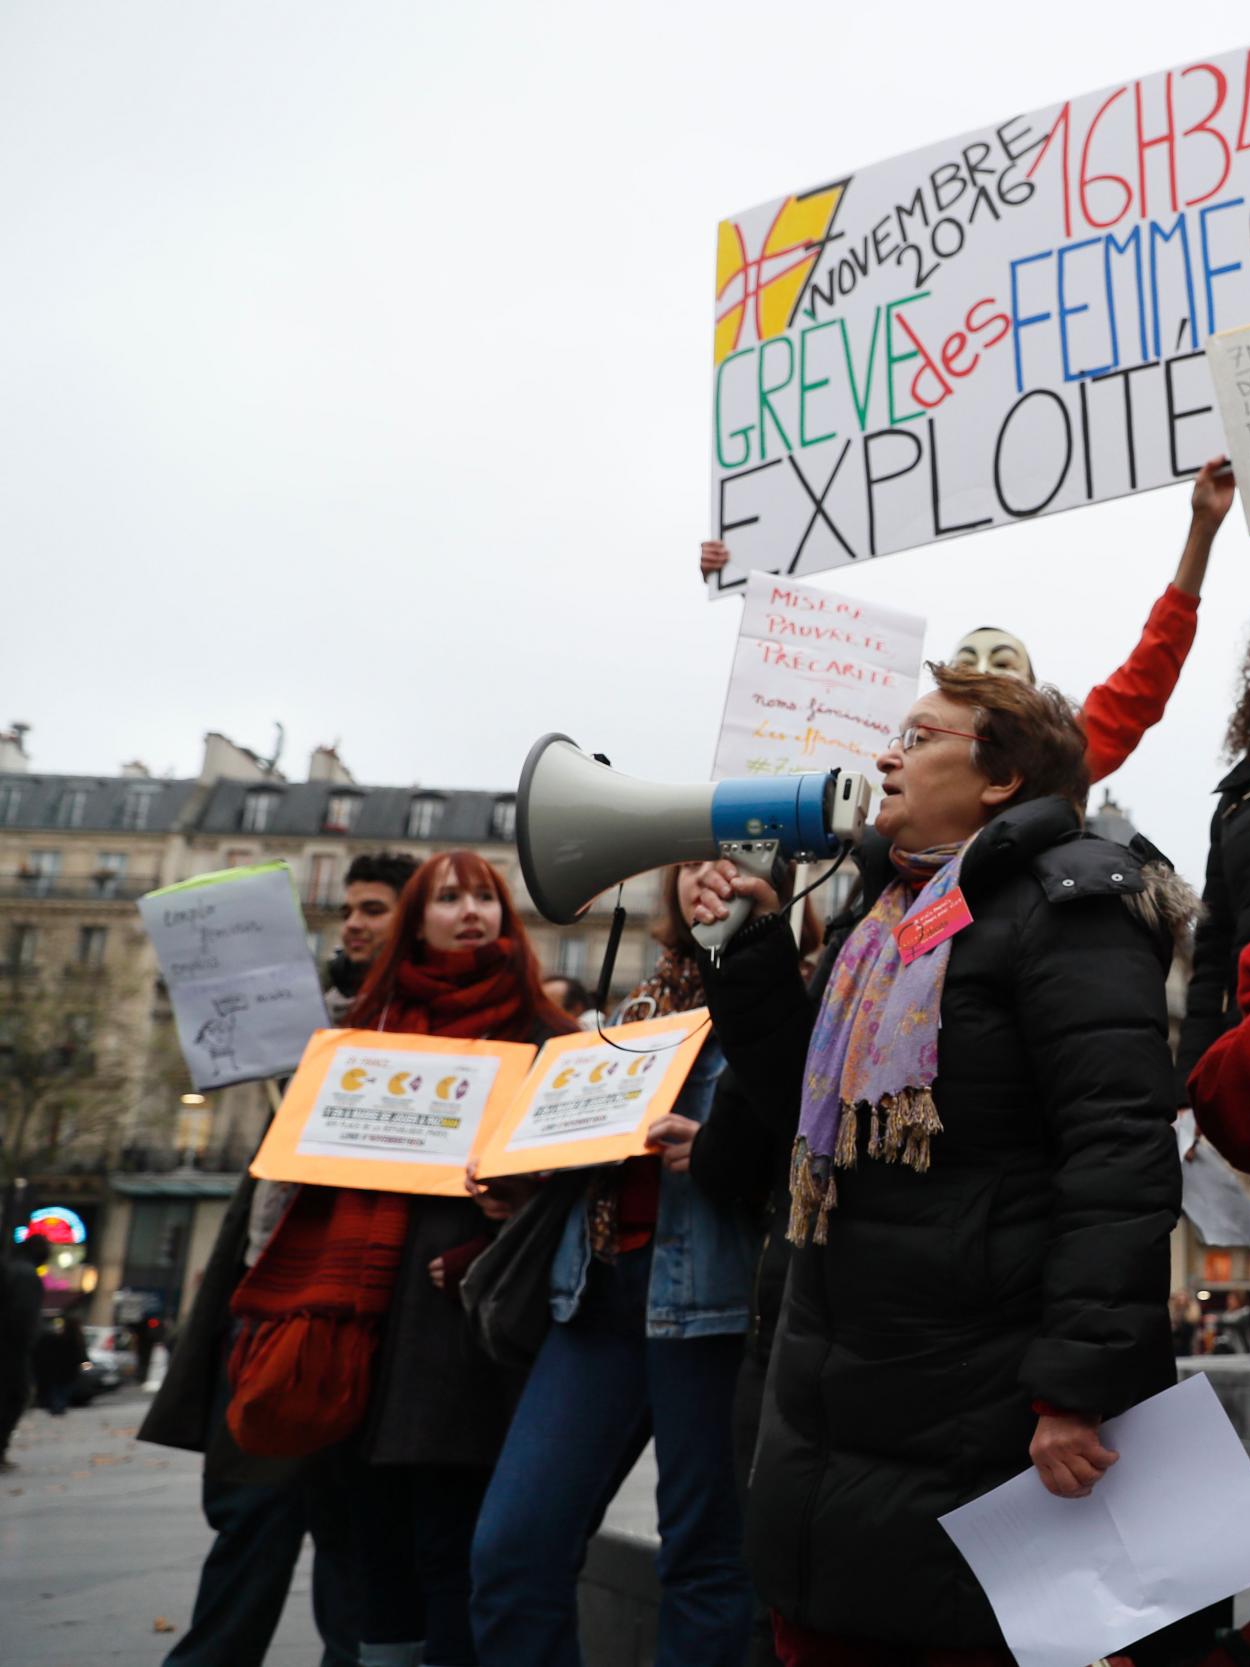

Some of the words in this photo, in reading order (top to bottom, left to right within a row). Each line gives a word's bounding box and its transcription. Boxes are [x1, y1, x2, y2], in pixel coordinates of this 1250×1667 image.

[811, 114, 1049, 316] NOVEMBRE
[896, 162, 1034, 288] 2016
[894, 298, 1011, 408] des
